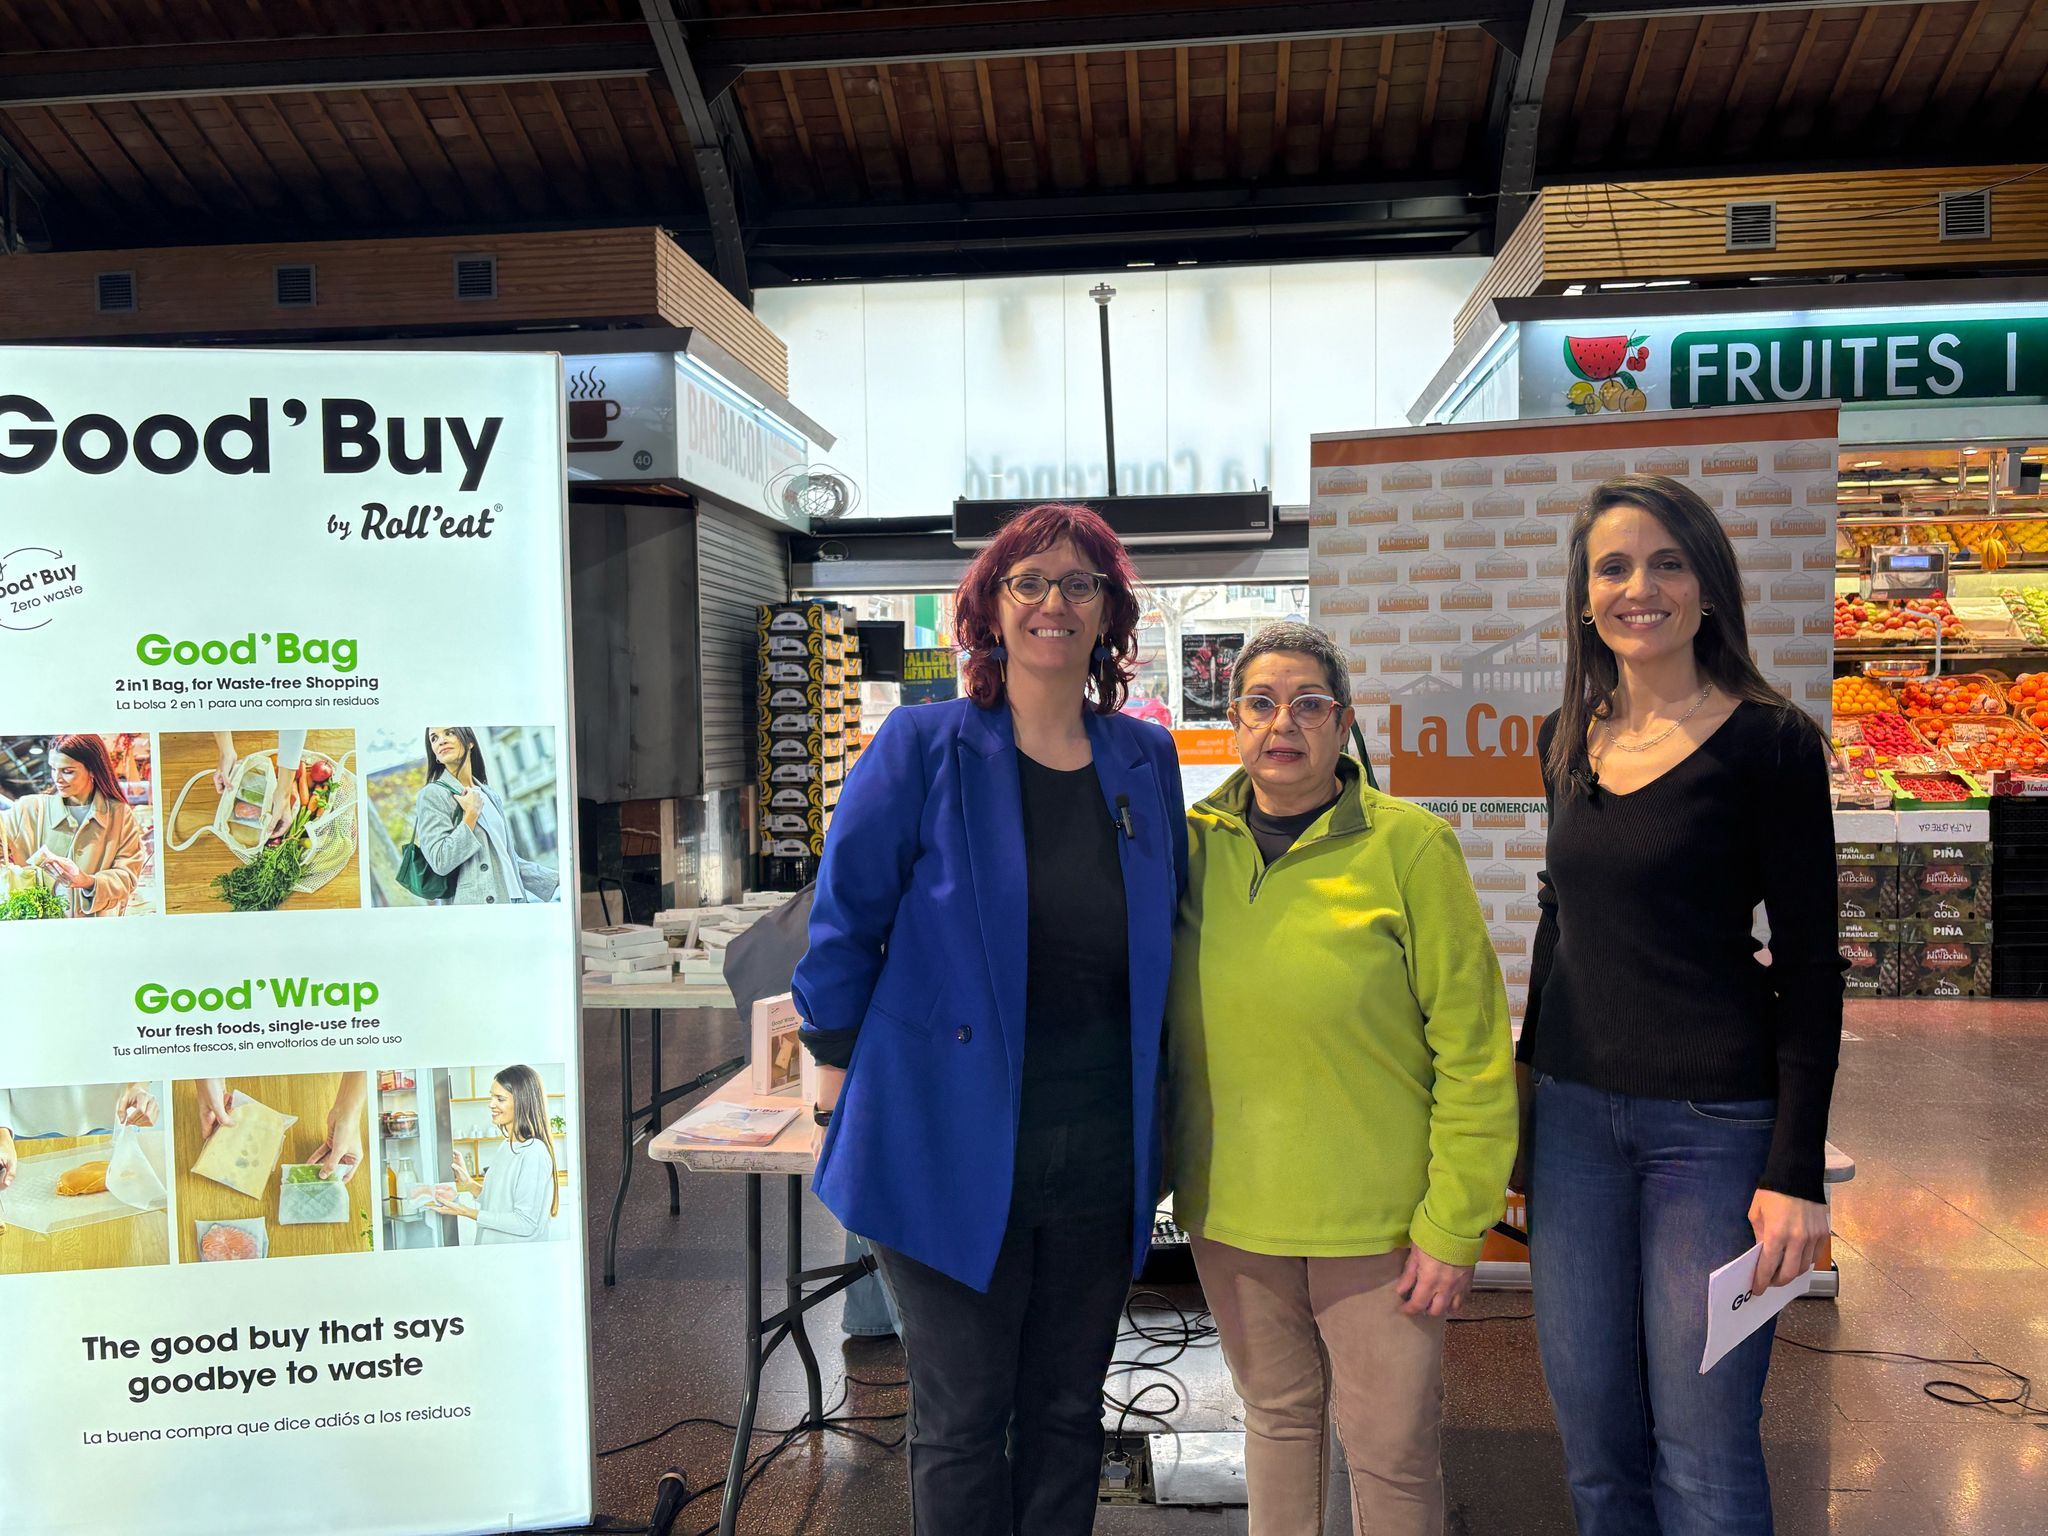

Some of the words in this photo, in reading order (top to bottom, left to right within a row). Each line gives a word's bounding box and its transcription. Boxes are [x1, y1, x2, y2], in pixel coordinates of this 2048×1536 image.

[1689, 333, 1965, 402] FRUITES
[2006, 331, 2017, 392] I
[0, 395, 504, 491] Good'Buy
[634, 454, 651, 466] 40
[327, 514, 352, 540] by
[10, 598, 41, 613] Zero
[44, 586, 83, 602] waste
[136, 633, 357, 672] Good'Bag
[153, 679, 188, 694] Bag,
[192, 678, 213, 690] for
[216, 677, 301, 689] Waste-free
[306, 676, 378, 690] Shopping
[117, 700, 130, 709] La
[134, 700, 166, 709] bolsa
[171, 699, 177, 709] 2
[181, 701, 195, 709] en
[199, 699, 203, 708] 1
[209, 700, 236, 710] para
[266, 699, 312, 708] compra
[315, 697, 330, 706] sin
[333, 696, 379, 706] residuos
[1390, 704, 1448, 757] La
[1462, 803, 1476, 813] DE
[1933, 847, 1964, 858] PIÑA
[1933, 924, 1964, 936] PIÑA
[135, 977, 379, 1014] Good'Wrap
[1934, 987, 1960, 996] GOLD
[137, 1026, 171, 1038] Your
[175, 1023, 212, 1036] fresh
[217, 1021, 264, 1034] foods,
[269, 1019, 347, 1034] single-use
[351, 1017, 380, 1028] free
[113, 1047, 130, 1056] Tus
[134, 1044, 190, 1055] alimentos
[194, 1043, 236, 1052] frescos,
[239, 1041, 253, 1050] sin
[257, 1038, 318, 1049] envoltorios
[321, 1037, 336, 1046] de
[357, 1035, 379, 1044] solo
[82, 1336, 140, 1360] The
[151, 1327, 238, 1363] good
[250, 1326, 310, 1352] buy
[319, 1317, 384, 1344] that
[394, 1317, 464, 1342] says
[128, 1366, 276, 1403] goodbye
[286, 1361, 317, 1384] to
[328, 1353, 423, 1381] waste
[84, 1432, 101, 1444] La
[107, 1430, 161, 1442] buena
[166, 1425, 232, 1439] compra
[237, 1422, 269, 1436] que
[274, 1418, 310, 1431] dice
[315, 1412, 359, 1428] adiós
[364, 1414, 374, 1424] a
[380, 1410, 401, 1423] los
[406, 1406, 471, 1421] residuos
